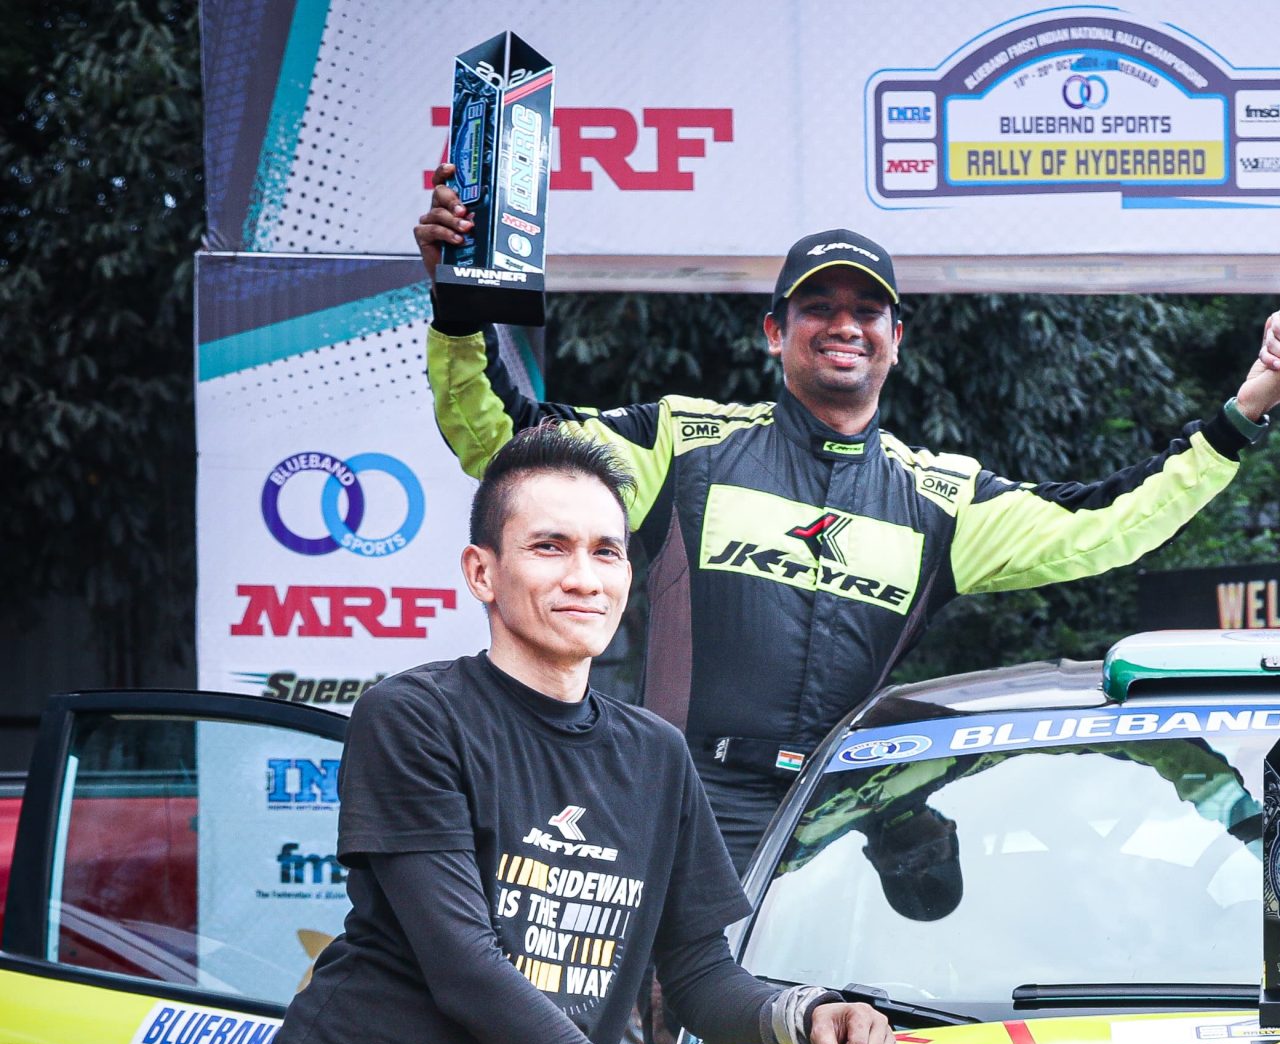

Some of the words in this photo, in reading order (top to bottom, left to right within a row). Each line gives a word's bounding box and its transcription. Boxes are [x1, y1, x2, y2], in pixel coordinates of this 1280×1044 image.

[1001, 116, 1094, 135] BLUEBAND
[1101, 116, 1172, 134] SPORTS
[423, 107, 733, 190] RF
[885, 159, 934, 173] MRF
[966, 149, 1033, 176] RALLY
[1042, 149, 1068, 175] OF
[1076, 149, 1206, 176] HYDERABAD
[502, 212, 541, 236] MRF
[453, 266, 527, 283] WINNER
[681, 424, 720, 438] OMP
[270, 453, 355, 487] BLUEBAND
[921, 477, 958, 498] OMP
[341, 533, 407, 556] SPORTS
[230, 585, 457, 638] MRF
[547, 866, 645, 908] SIDEWAYS
[497, 888, 522, 918] IS
[527, 893, 561, 929] THE
[524, 925, 573, 961] ONLY
[566, 966, 613, 998] WAY
